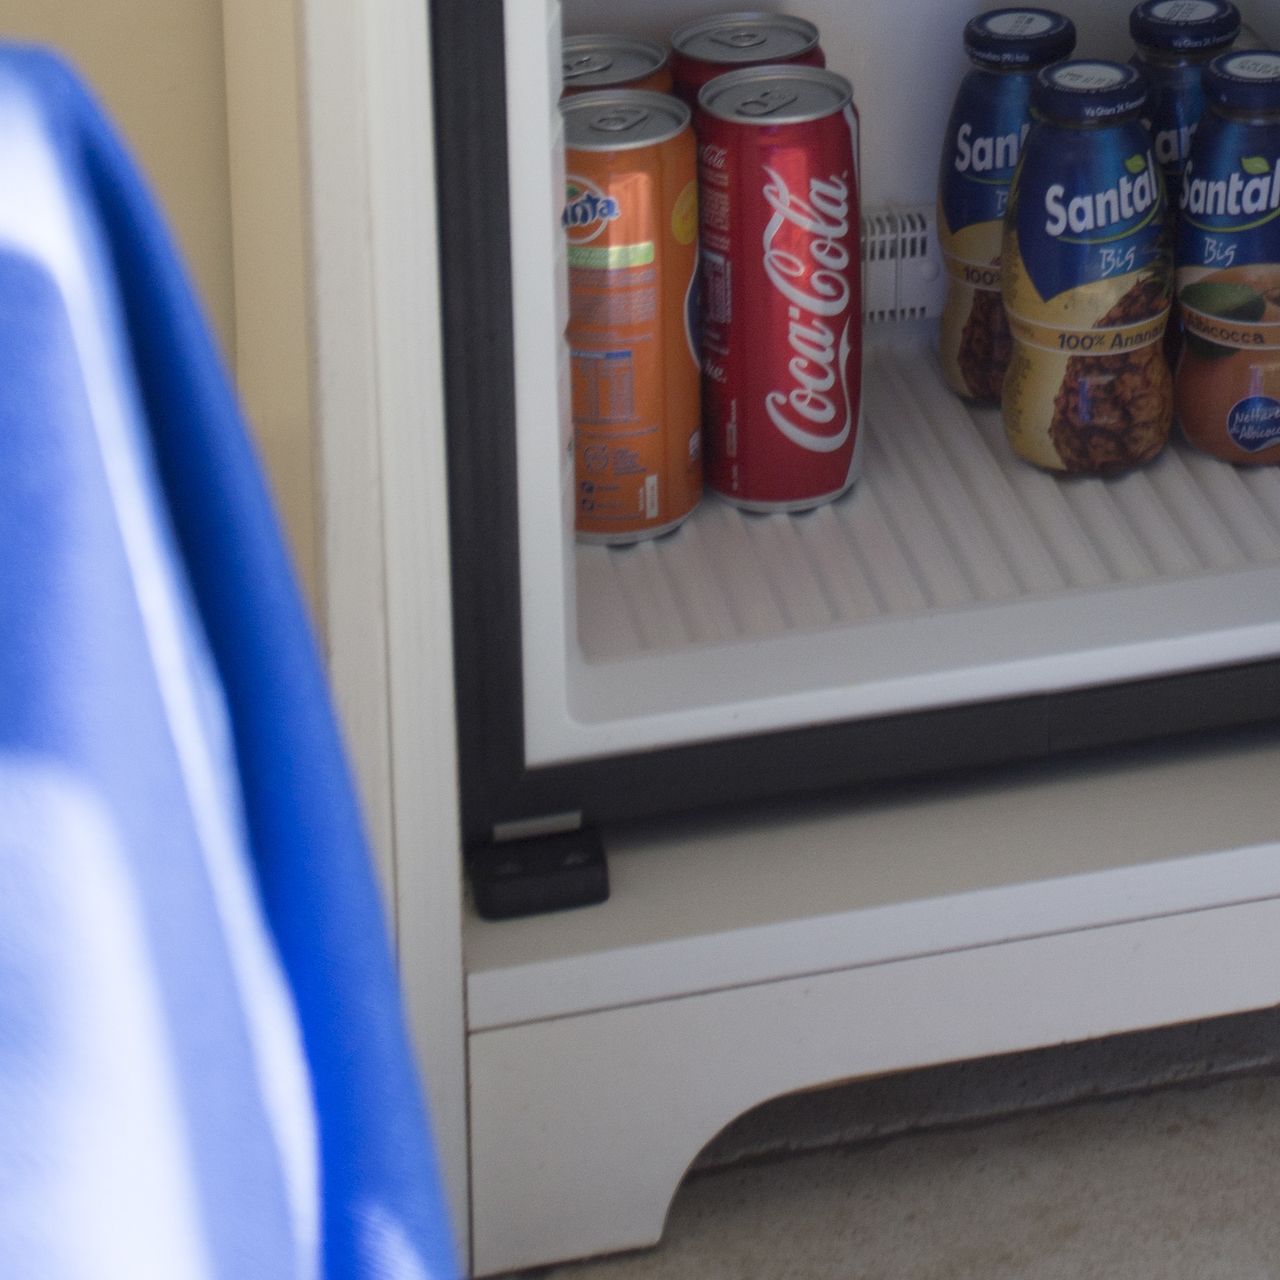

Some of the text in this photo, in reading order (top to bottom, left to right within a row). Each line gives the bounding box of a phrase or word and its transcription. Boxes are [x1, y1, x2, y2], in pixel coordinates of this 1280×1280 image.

[954, 123, 1031, 172] San
[1044, 147, 1158, 236] Santal
[1098, 245, 1137, 277] Big
[1203, 236, 1238, 267] Big
[762, 164, 851, 453] Coca-Cola
[1058, 332, 1106, 351] 100%
